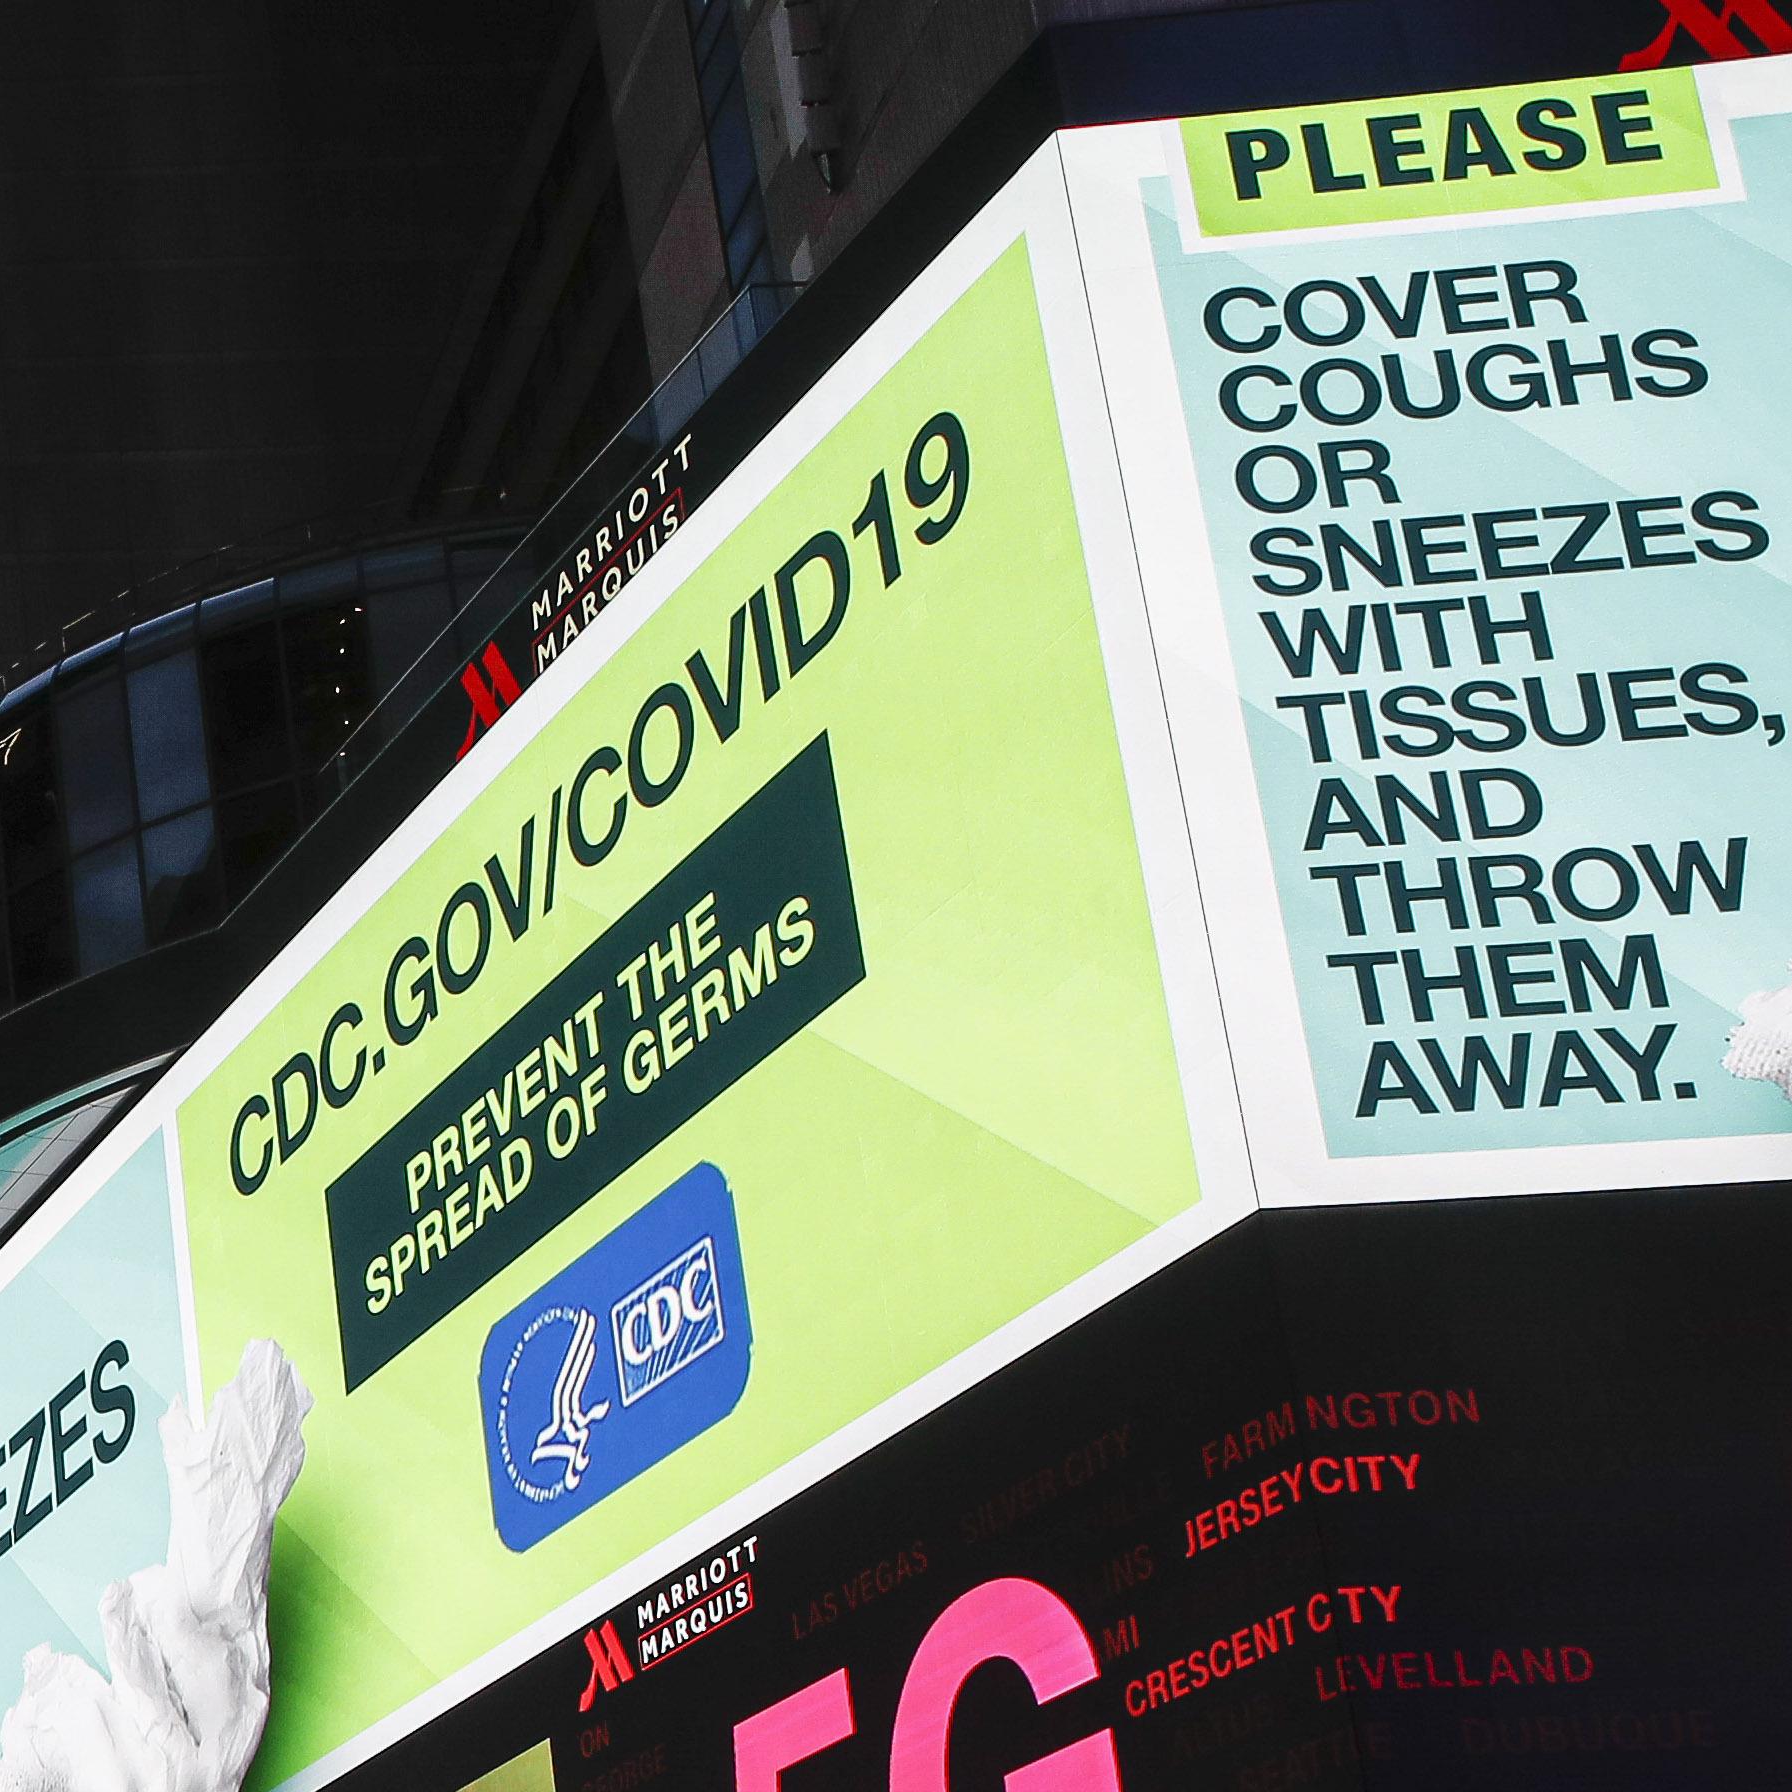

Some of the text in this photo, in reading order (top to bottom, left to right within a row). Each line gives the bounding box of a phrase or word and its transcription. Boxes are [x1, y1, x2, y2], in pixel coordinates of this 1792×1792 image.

[1225, 89, 1664, 200] PLEASE
[1204, 260, 1587, 356] COVER
[1218, 328, 1710, 434] COUGHS
[1234, 438, 1399, 515] OR
[529, 434, 695, 630] MARRIOTT
[1251, 491, 1771, 598] SNEEZES
[534, 502, 683, 672] MARQUIS
[1259, 592, 1555, 680] WITH
[1276, 662, 1785, 764] TISSUES,
[226, 409, 975, 1198] CDC.GOV/COVID19
[1303, 767, 1544, 853] AND
[1311, 836, 1749, 938] THROW
[1328, 934, 1668, 1026] THEM
[404, 892, 724, 1212] PREVENT THE
[1354, 1023, 1696, 1119] AWAY.
[364, 895, 817, 1320] SPREAD OF GERMS
[1182, 1452, 1423, 1559] JERSEY CITY
[635, 1534, 761, 1627] MARRIOTT
[639, 1579, 751, 1667] MARQUIS
[1123, 1605, 1298, 1720] CRESCENT
[1315, 1645, 1595, 1703] LEVELLAND
